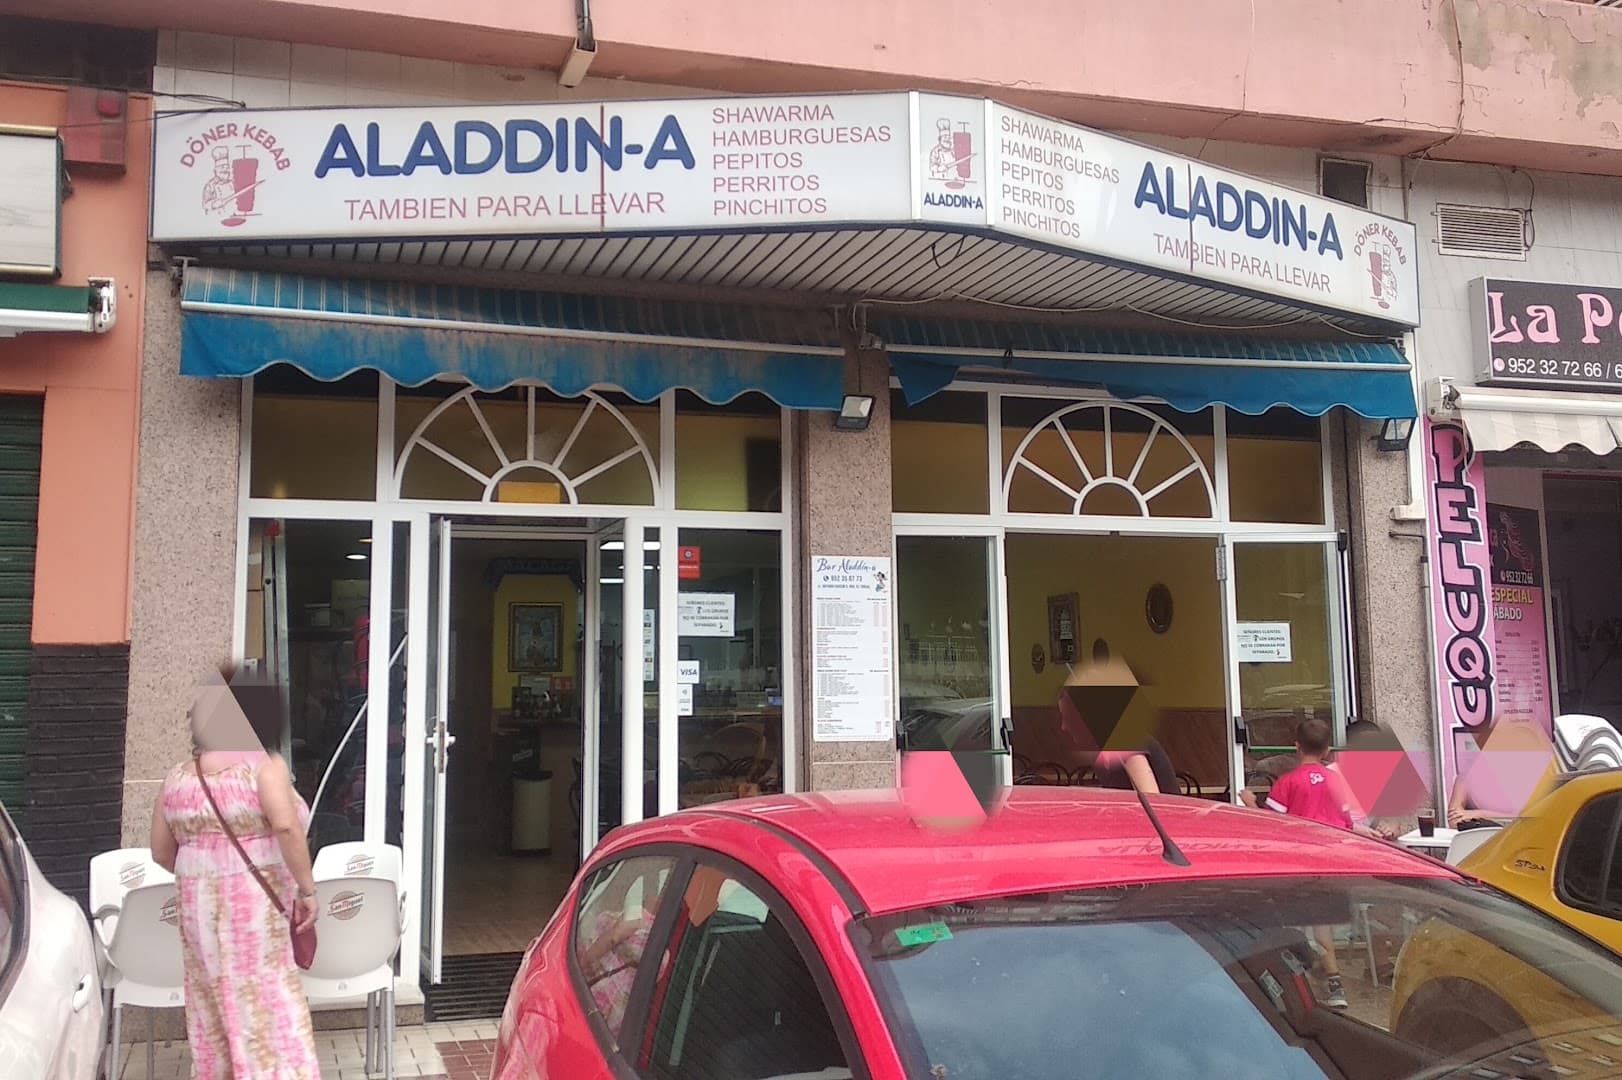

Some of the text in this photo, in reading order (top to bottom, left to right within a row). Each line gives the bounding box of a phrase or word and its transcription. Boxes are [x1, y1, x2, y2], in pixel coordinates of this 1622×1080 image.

[712, 104, 835, 124] SHAWARMA
[180, 123, 291, 171] DÖNER KEBAB
[314, 114, 696, 178] ALADDIN-A
[712, 126, 892, 147] HAMBURGUESAS
[1001, 115, 1084, 152] SHAWARMA
[713, 152, 803, 170] PEPITOS
[1001, 138, 1120, 184] HAMBURGUESAS
[1001, 161, 1064, 191] PEPITOS
[713, 175, 820, 193] PERRITOS
[344, 192, 665, 221] TAMBIEN PARA LLEVAR
[713, 198, 827, 216] PINCHITOS
[924, 192, 984, 210] ALADDIN-A
[1002, 184, 1075, 215] PERRITOS
[1134, 161, 1343, 261] ALADDIN-A
[1003, 207, 1080, 238] PINCHITOS
[1353, 223, 1407, 265] DÖNER KEBAB
[1153, 233, 1331, 293] TAMBIEN PARA LLEVAR
[1487, 292, 1622, 344] La P
[1508, 358, 1536, 374] 952
[1540, 360, 1558, 375] 32
[1561, 361, 1580, 376] 72
[1584, 362, 1602, 377] 66
[680, 668, 697, 676] VISA
